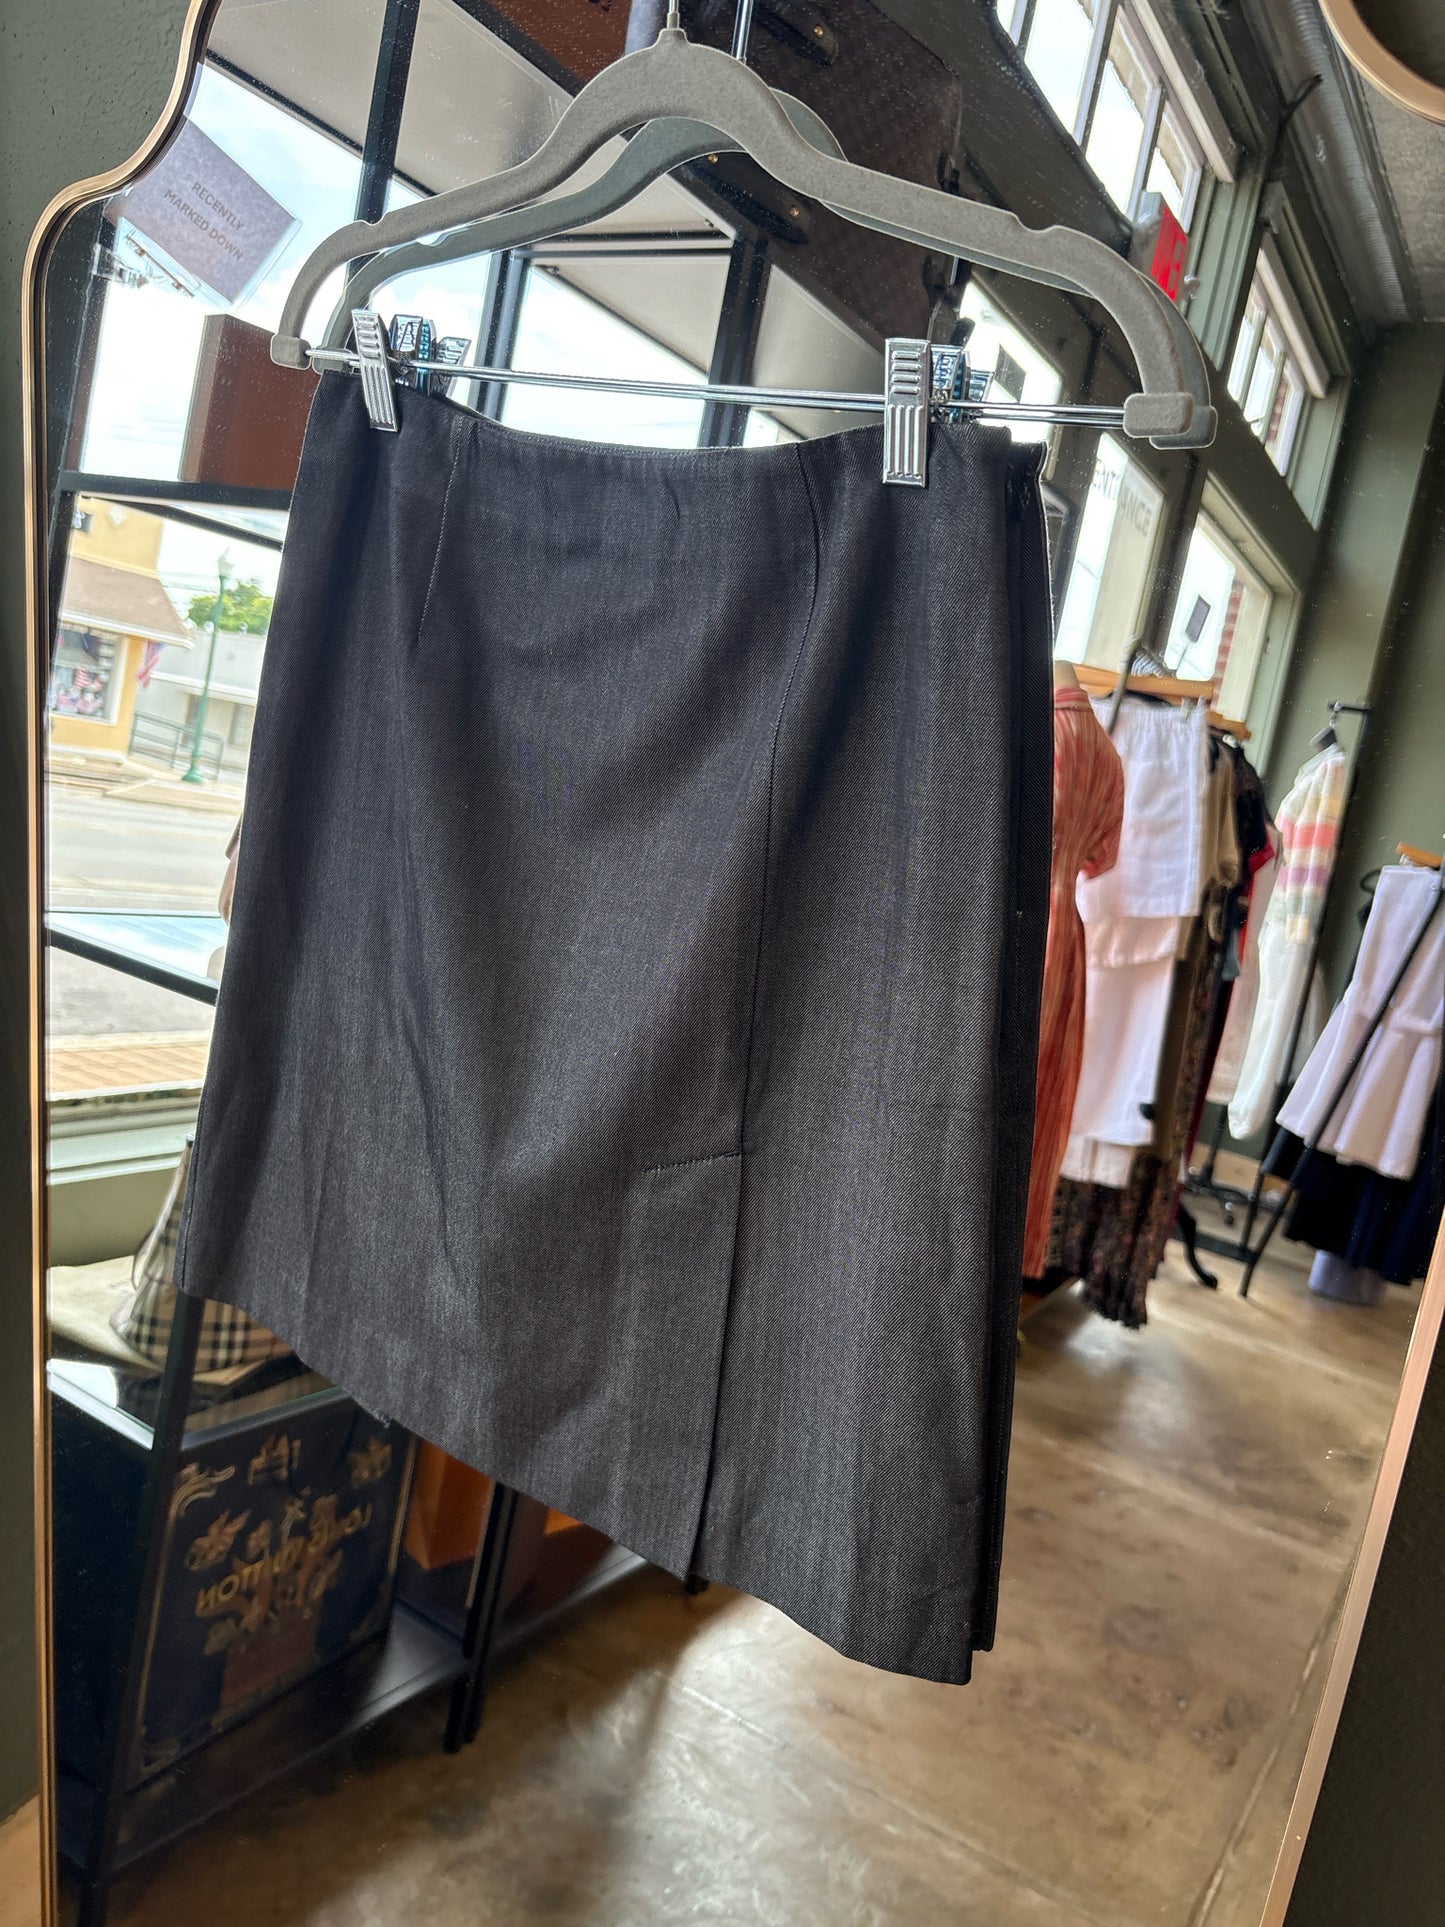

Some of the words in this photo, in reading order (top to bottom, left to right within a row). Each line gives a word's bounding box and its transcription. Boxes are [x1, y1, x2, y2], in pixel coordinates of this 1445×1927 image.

[163, 188, 210, 232] MARKED
[208, 227, 244, 260] DOWN
[191, 181, 246, 231] RECENTLY
